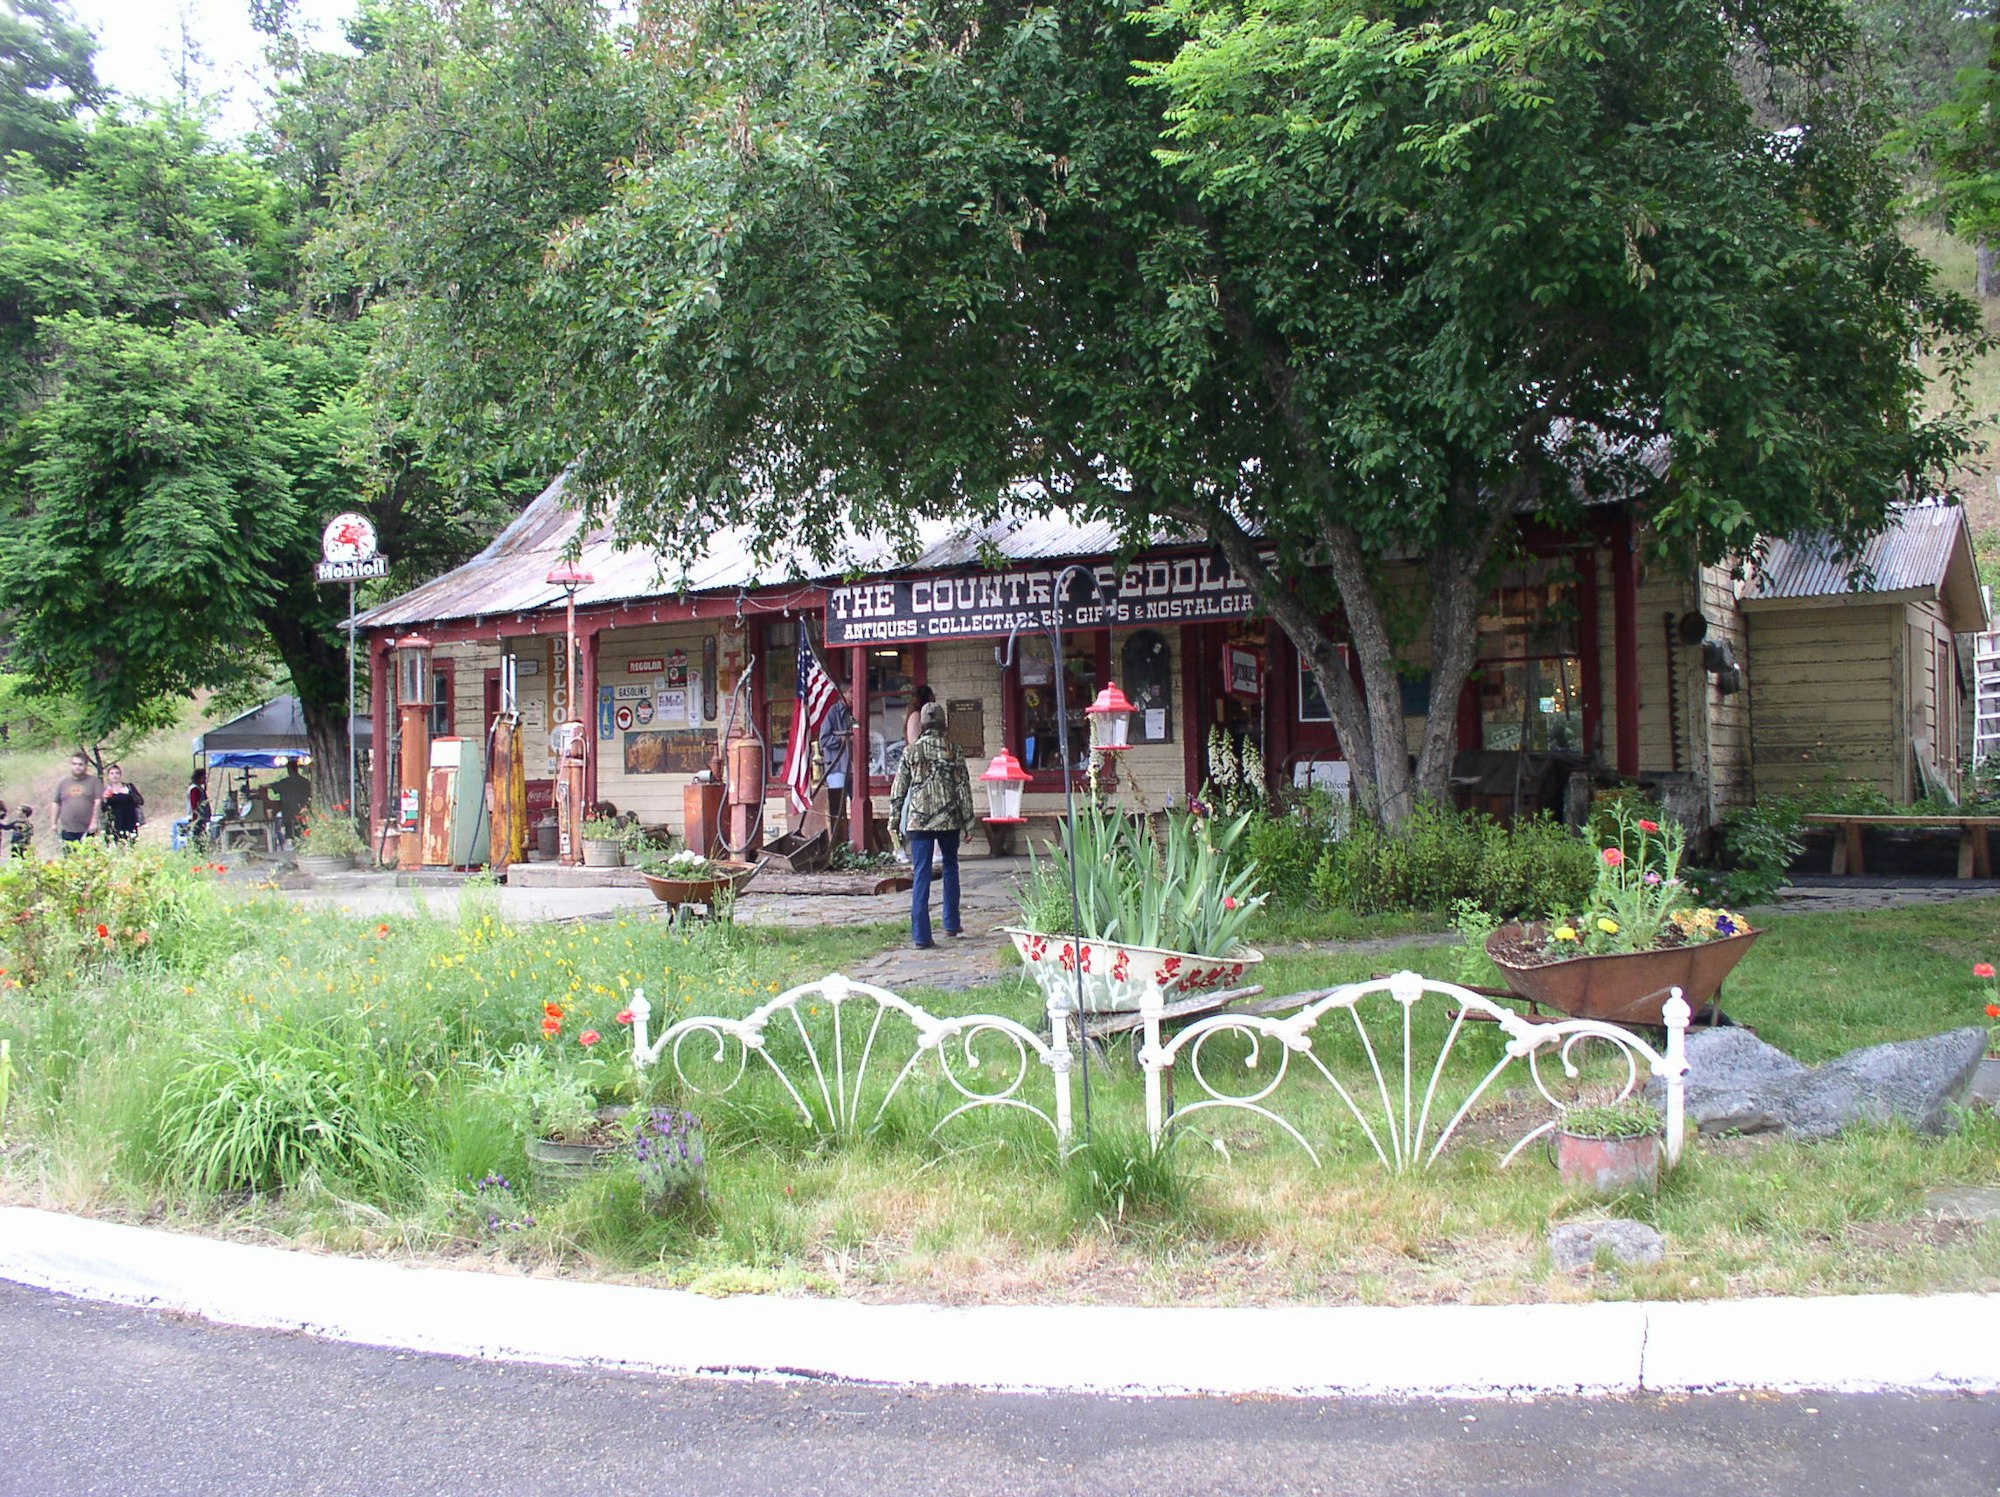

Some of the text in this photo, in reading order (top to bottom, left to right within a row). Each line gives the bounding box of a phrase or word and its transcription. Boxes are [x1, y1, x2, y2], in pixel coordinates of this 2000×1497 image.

[319, 559, 385, 579] Mobiloil
[833, 583, 895, 619] THE
[912, 570, 1076, 613] COUNTRY
[843, 619, 918, 640] ANTIQUES
[1134, 605, 1144, 619] &
[1146, 594, 1254, 619] NOSTALGIA
[553, 638, 567, 723] DELCO
[629, 660, 662, 673] REGULAR
[618, 686, 648, 697] GASOLINE
